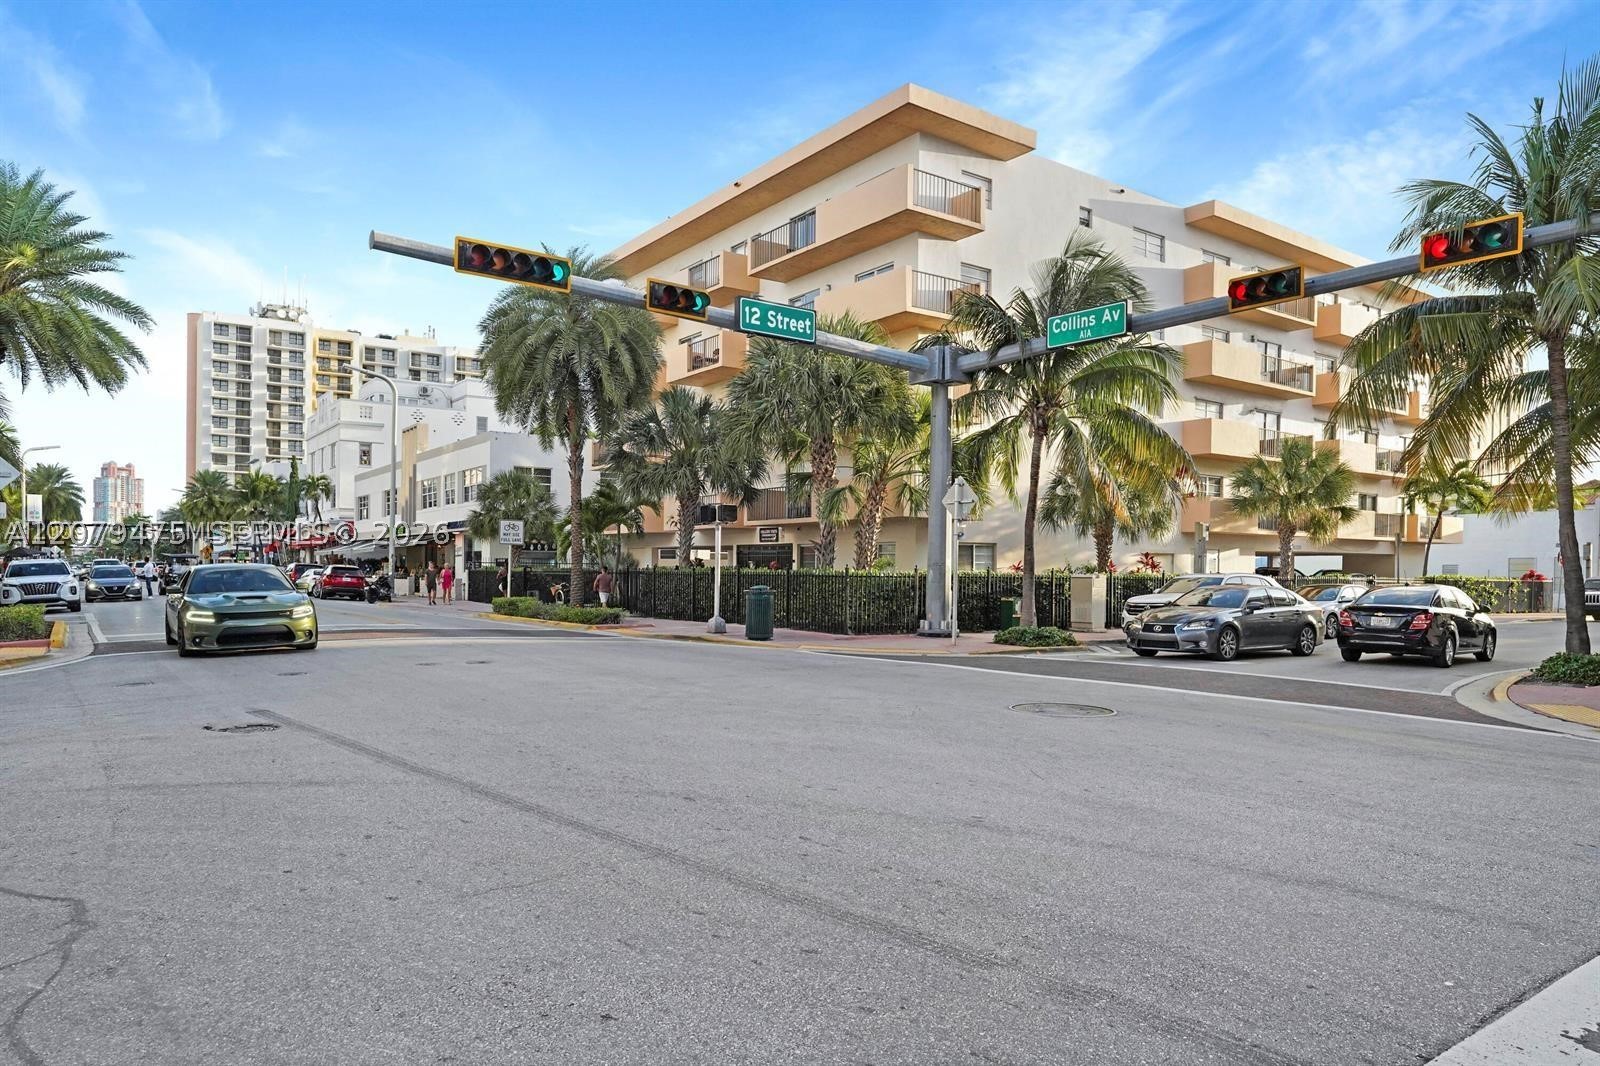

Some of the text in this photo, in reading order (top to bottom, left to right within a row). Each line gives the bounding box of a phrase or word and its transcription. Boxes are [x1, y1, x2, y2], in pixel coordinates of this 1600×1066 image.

[744, 306, 811, 334] 12 Street
[1052, 308, 1120, 334] Collins Av
[1079, 329, 1092, 339] A1A
